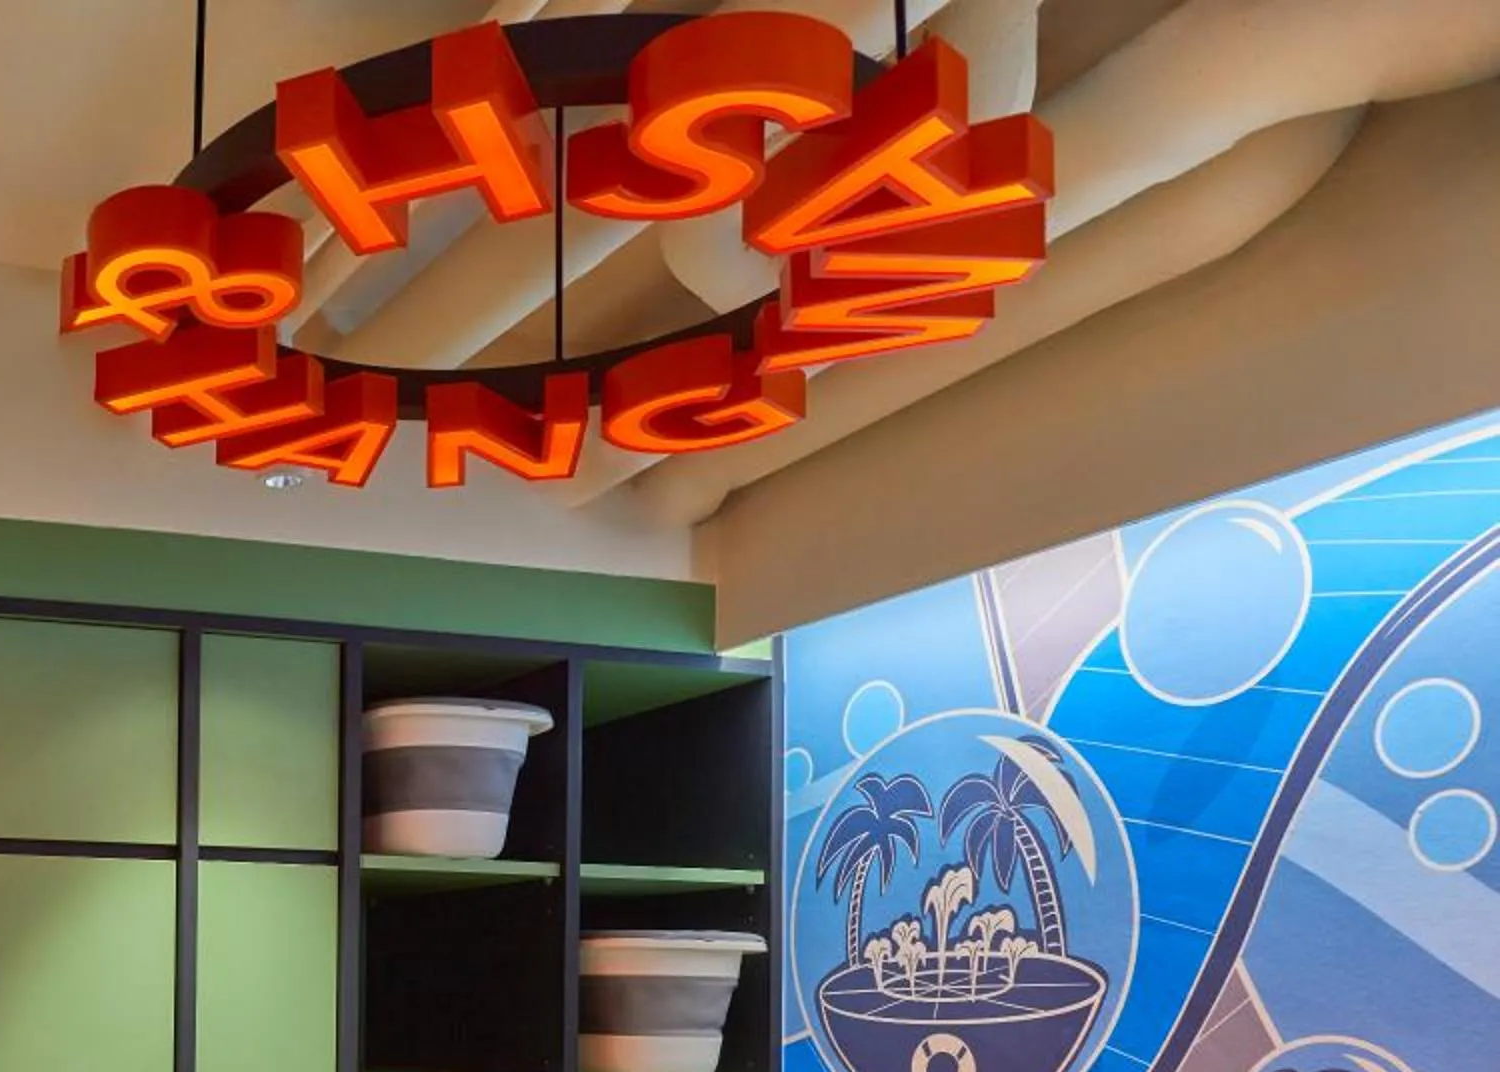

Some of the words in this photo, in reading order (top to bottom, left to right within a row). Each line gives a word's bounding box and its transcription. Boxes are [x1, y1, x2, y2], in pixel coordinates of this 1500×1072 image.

[276, 12, 1055, 374] WASH
[62, 200, 303, 343] &
[94, 334, 806, 488] HANG
